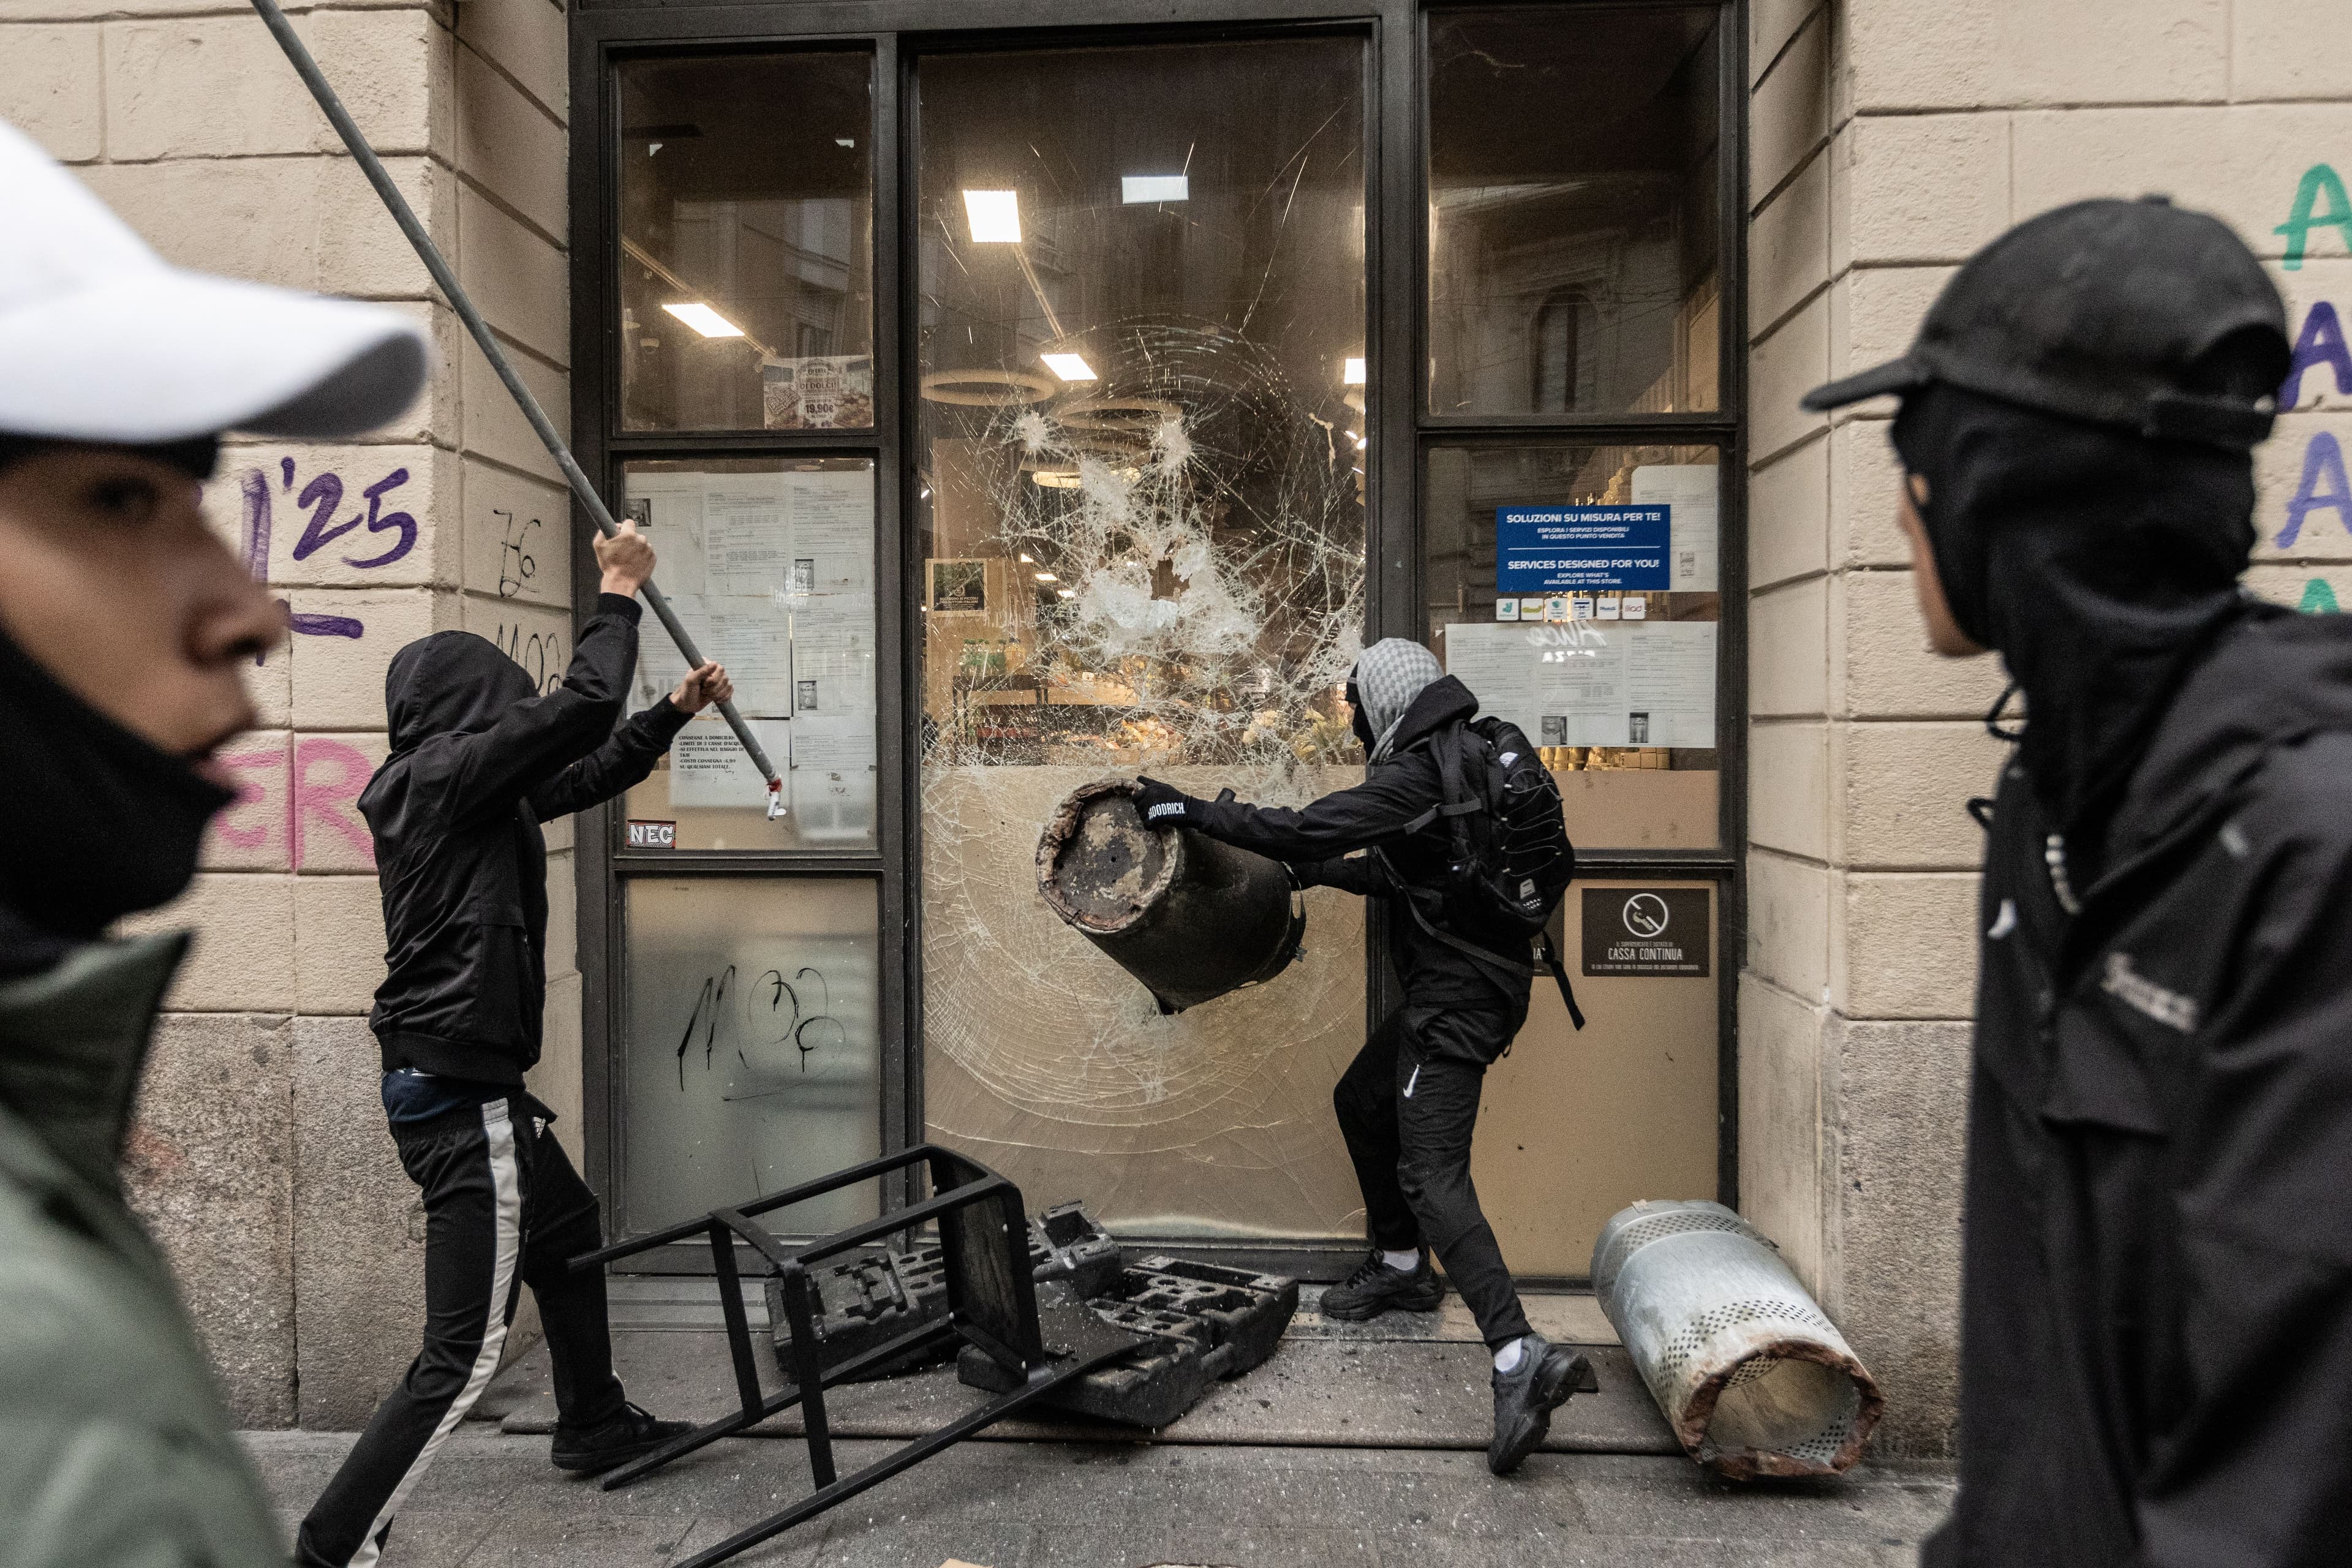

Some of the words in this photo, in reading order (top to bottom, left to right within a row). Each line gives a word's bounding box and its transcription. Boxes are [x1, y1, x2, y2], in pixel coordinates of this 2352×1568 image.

[2273, 164, 2352, 271] A
[2278, 302, 2352, 413] A
[805, 404, 834, 414] 19,90€
[2276, 431, 2352, 549] A
[1506, 514, 1562, 523] SOLUZIONI
[1564, 514, 1578, 522] SU
[1580, 513, 1622, 522] MISURA
[1623, 513, 1643, 521] PER
[1645, 512, 1660, 521] TE!
[1508, 560, 1556, 570] SERVICES
[1558, 560, 1610, 569] DESIGNED
[1611, 559, 1633, 568] FOR
[1634, 559, 1660, 568] YOU!
[1148, 802, 1184, 820] HOODRICH
[630, 823, 674, 845] NEC
[1608, 948, 1635, 960] CASSA
[1640, 948, 1683, 960] CONTINUA
